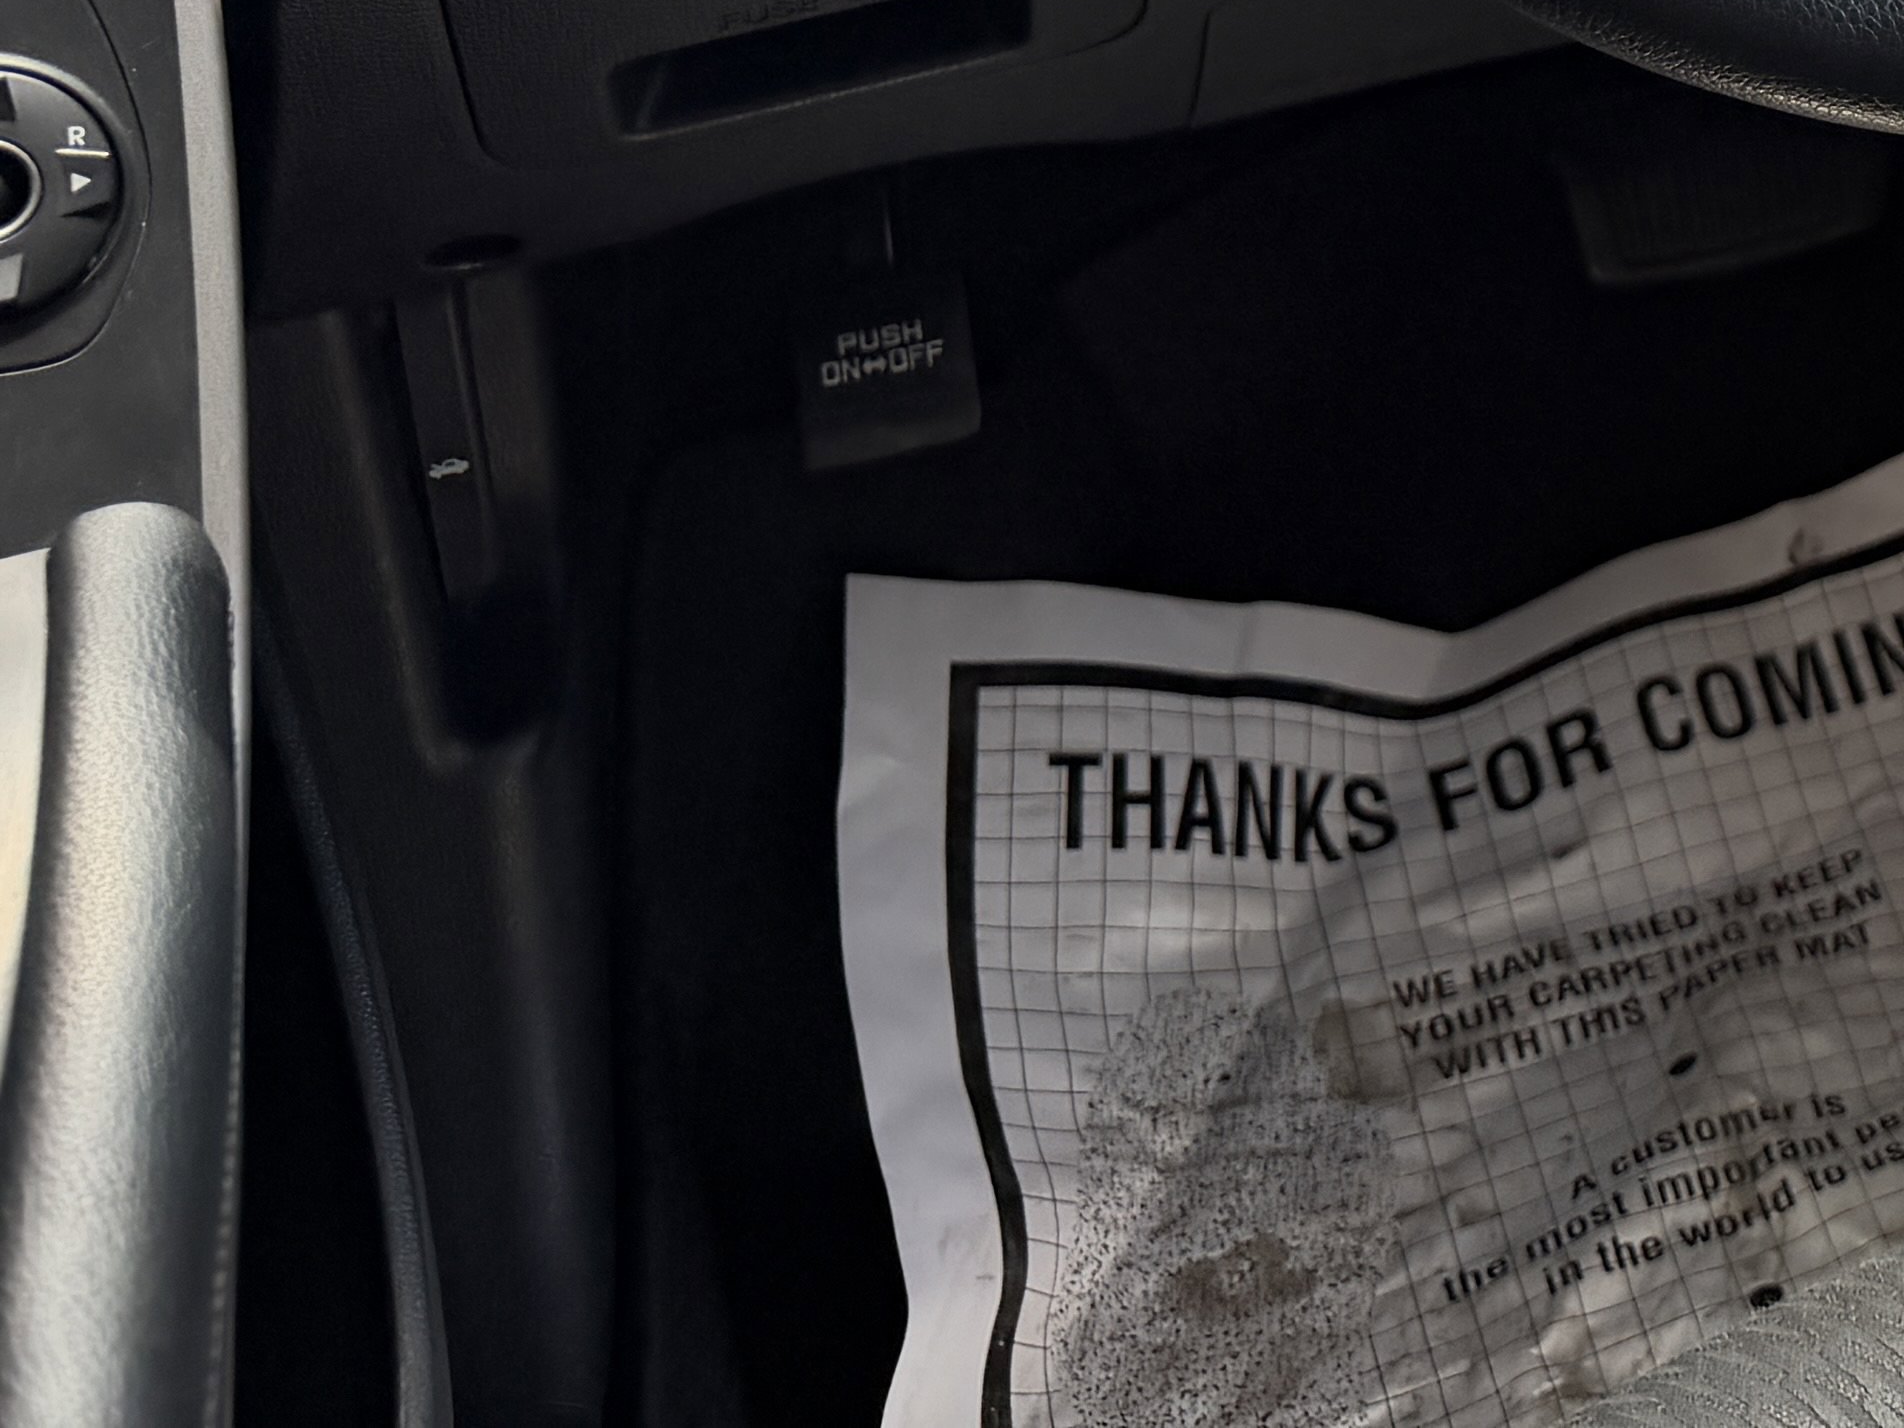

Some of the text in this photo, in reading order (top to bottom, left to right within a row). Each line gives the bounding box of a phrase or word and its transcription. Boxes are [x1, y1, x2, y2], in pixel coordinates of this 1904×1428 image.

[67, 125, 87, 146] R
[837, 318, 923, 356] PUSH
[1048, 749, 1399, 863] THANKS
[1428, 707, 1614, 833] FOR
[1392, 847, 1866, 1010] WE HAVE TRIED TO KEEP
[1400, 879, 1884, 1049] YOUR CARPETING CLEAN
[1430, 923, 1875, 1080] WITH THIS PAPER MAT
[1440, 1255, 1511, 1305] the
[1523, 1193, 1632, 1264] most
[1637, 1127, 1844, 1213] important
[1568, 1089, 1847, 1200] A customer is
[1544, 1261, 1585, 1297] in
[1595, 1232, 1665, 1277] the
[1677, 1181, 1797, 1248] world
[1805, 1162, 1848, 1196] to
